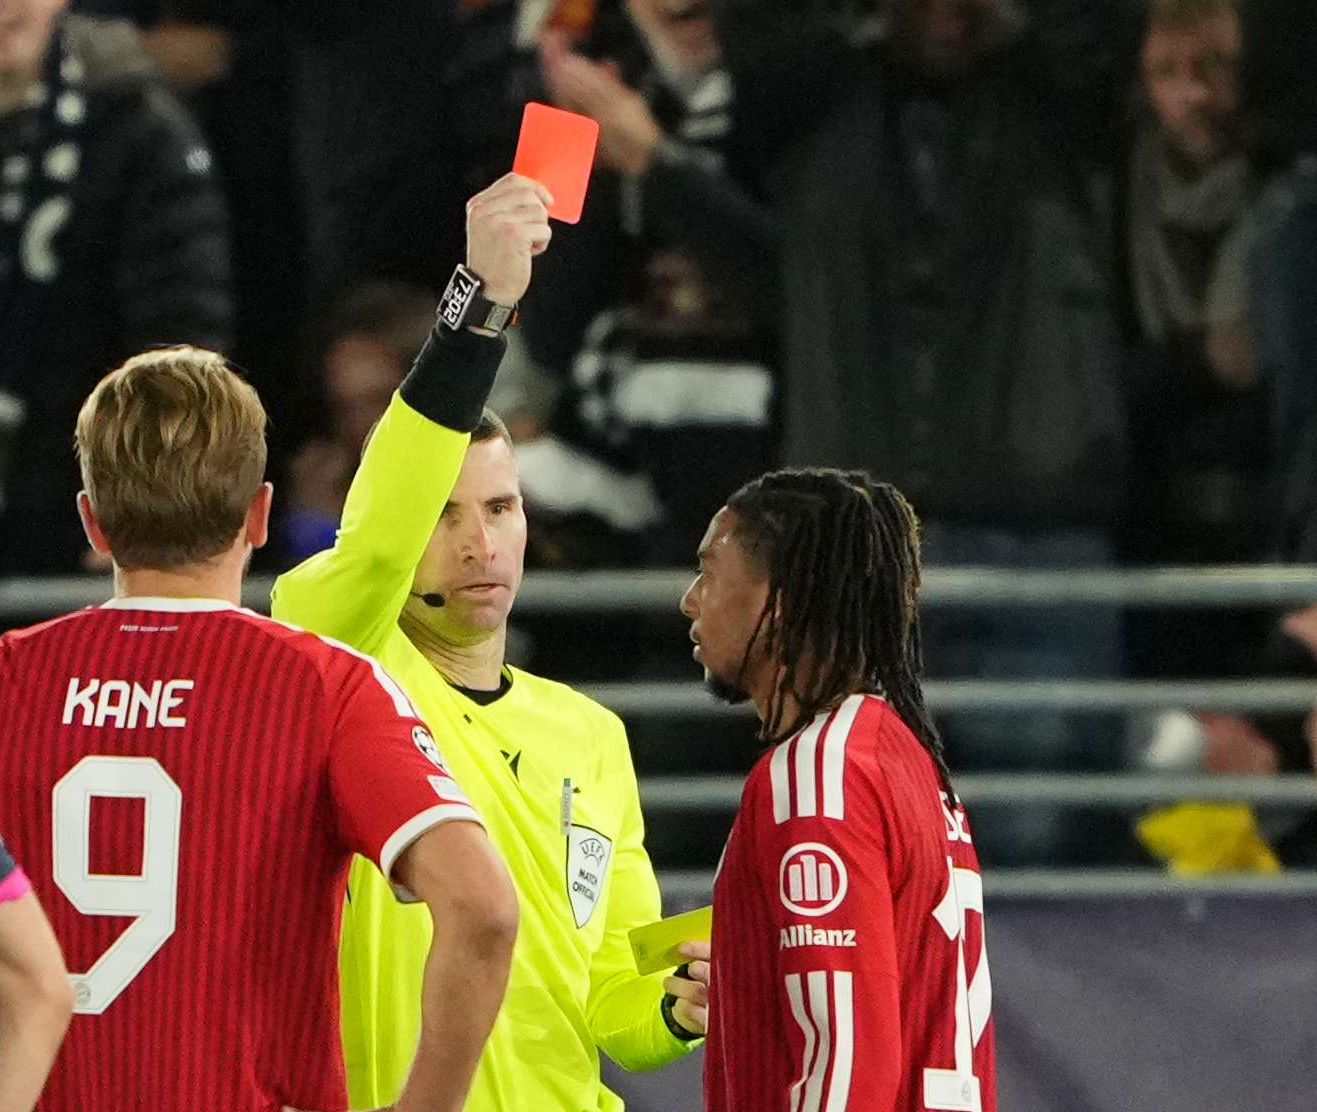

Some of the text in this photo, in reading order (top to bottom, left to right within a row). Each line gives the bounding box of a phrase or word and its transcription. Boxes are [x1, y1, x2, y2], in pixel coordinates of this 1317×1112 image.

[62, 677, 195, 729] KANE
[52, 755, 183, 1014] 9
[578, 868, 598, 886] MATCH
[780, 924, 857, 951] Allianz
